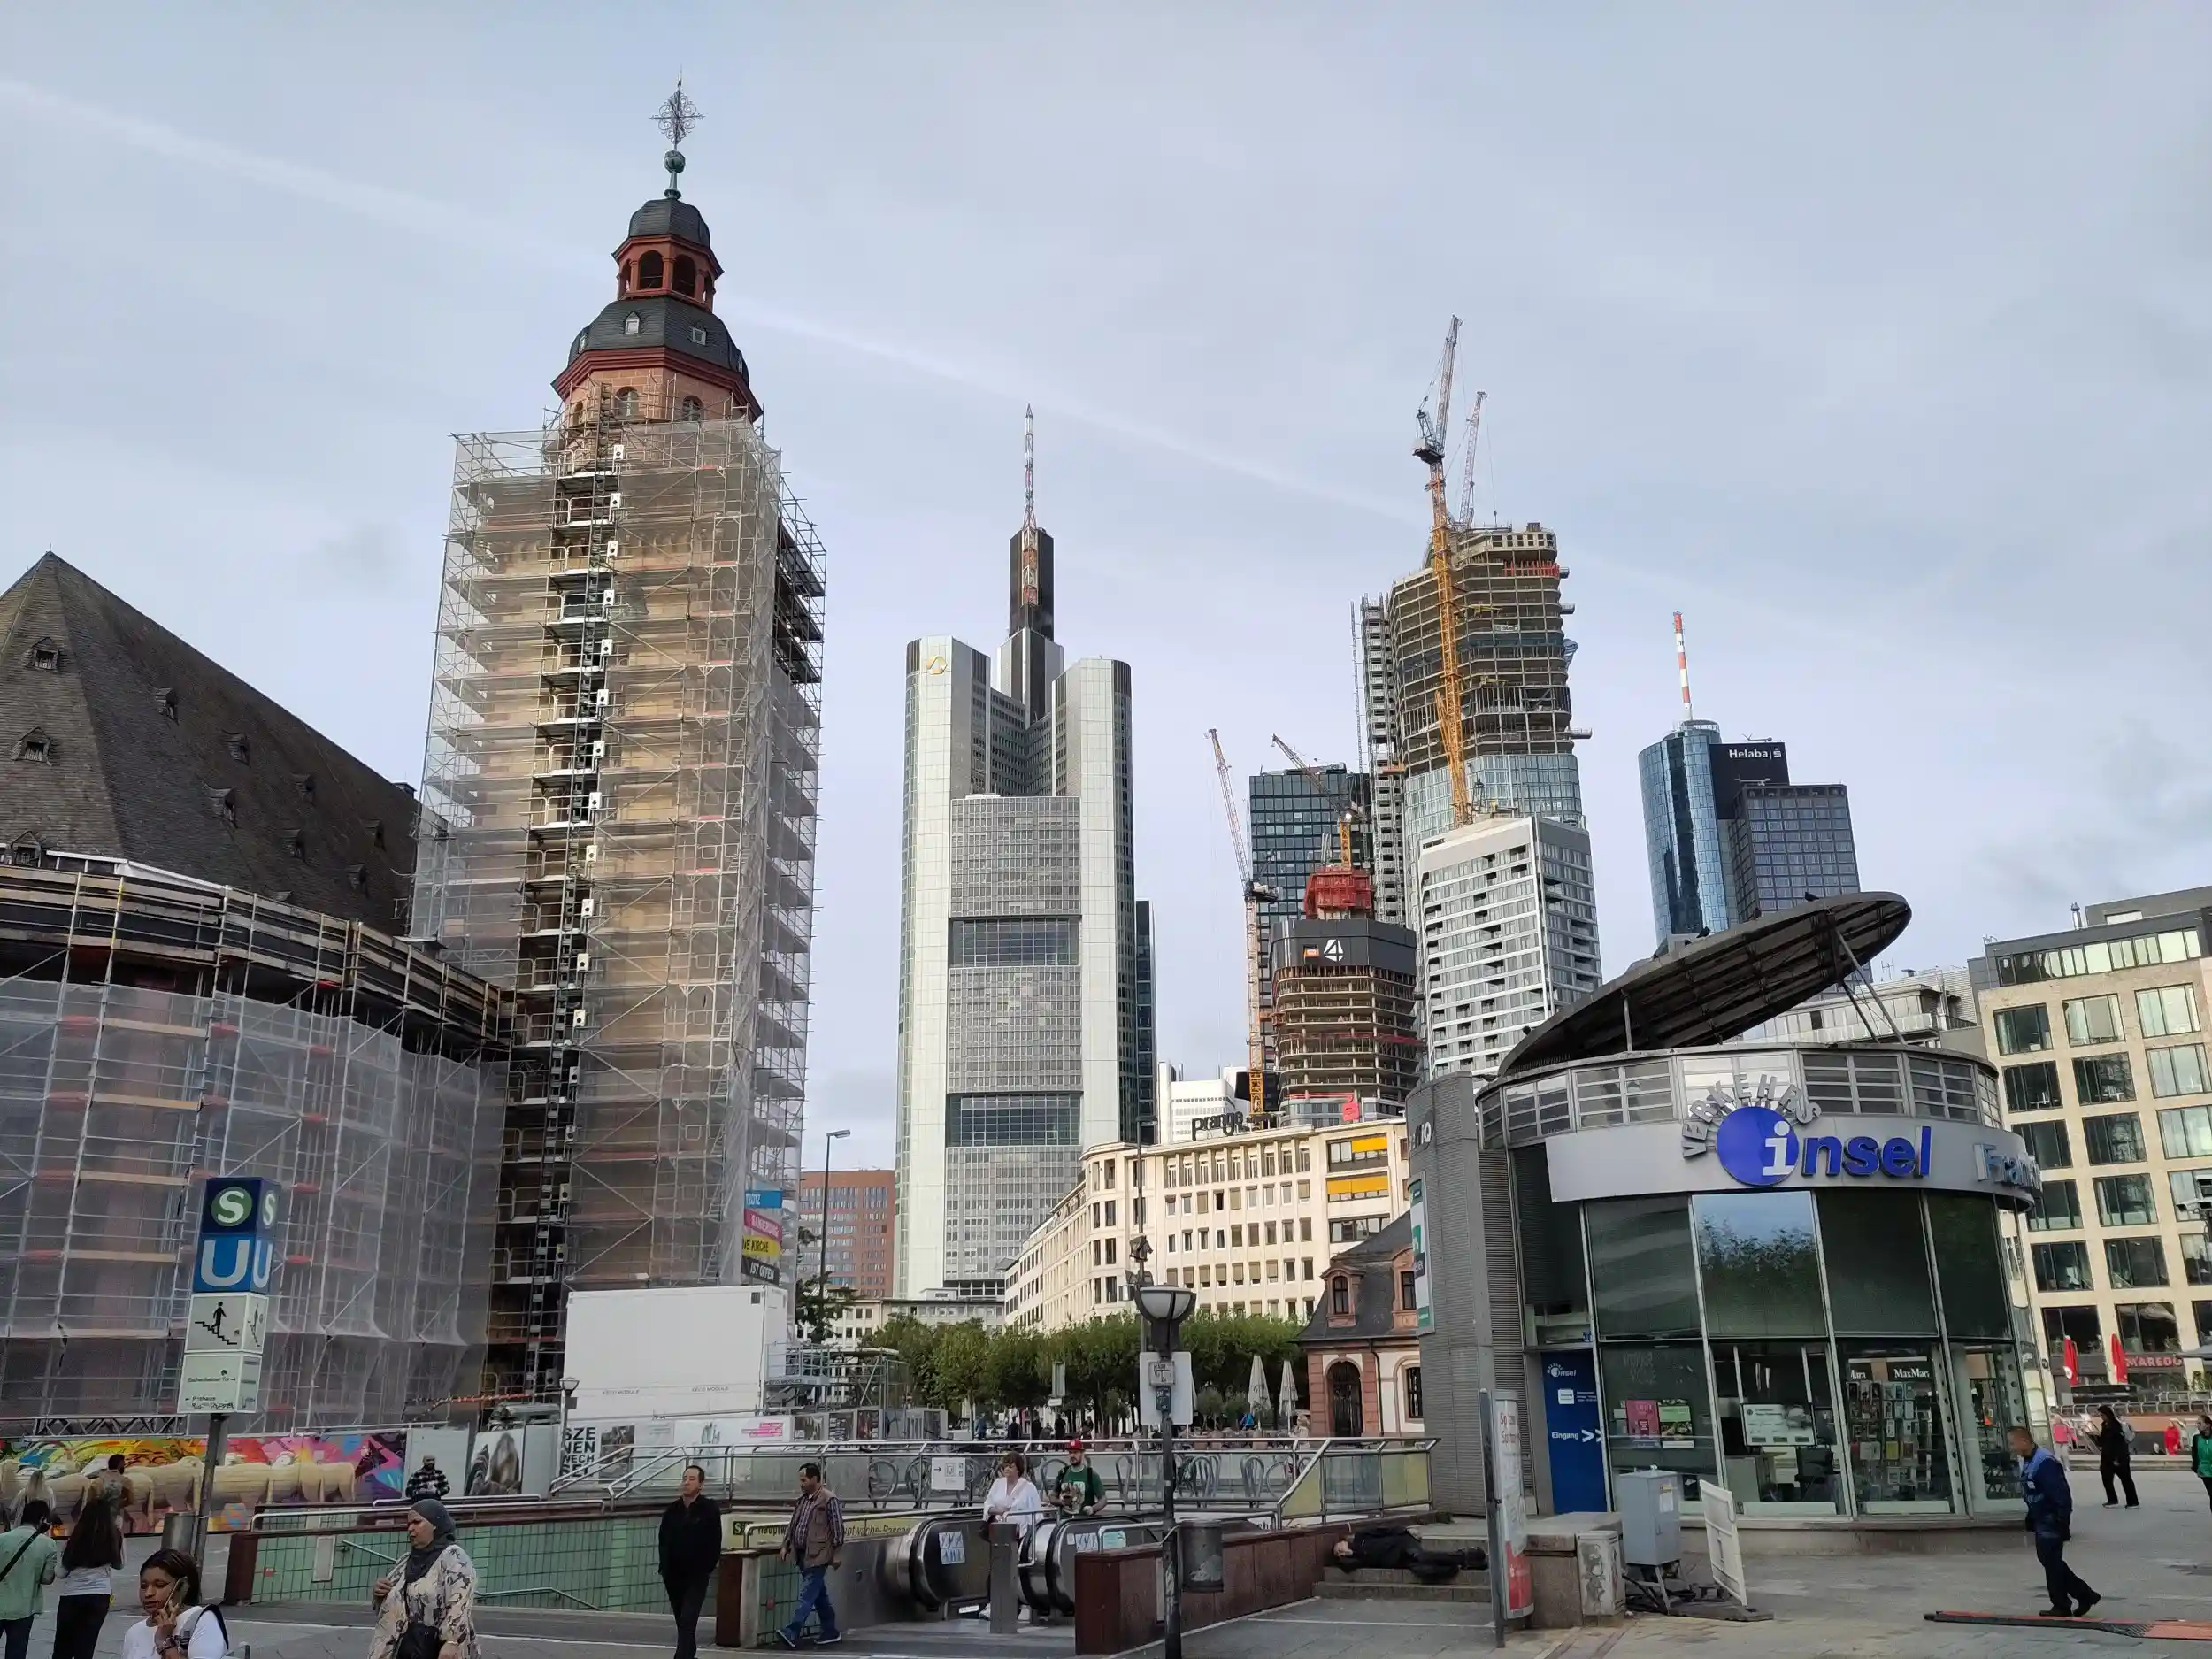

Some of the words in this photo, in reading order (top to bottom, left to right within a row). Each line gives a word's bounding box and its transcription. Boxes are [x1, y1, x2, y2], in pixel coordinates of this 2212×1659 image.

[1728, 748, 1769, 759] Helaba
[1191, 1111, 1244, 1141] prange
[1681, 1072, 1823, 1159] VERKEHRS
[1762, 1120, 1932, 1179] insel
[217, 1190, 245, 1225] S
[262, 1193, 276, 1226] S
[199, 1239, 250, 1287] U
[252, 1240, 273, 1288] U
[565, 1426, 596, 1441] SZE
[1551, 1432, 1579, 1440] Eingang
